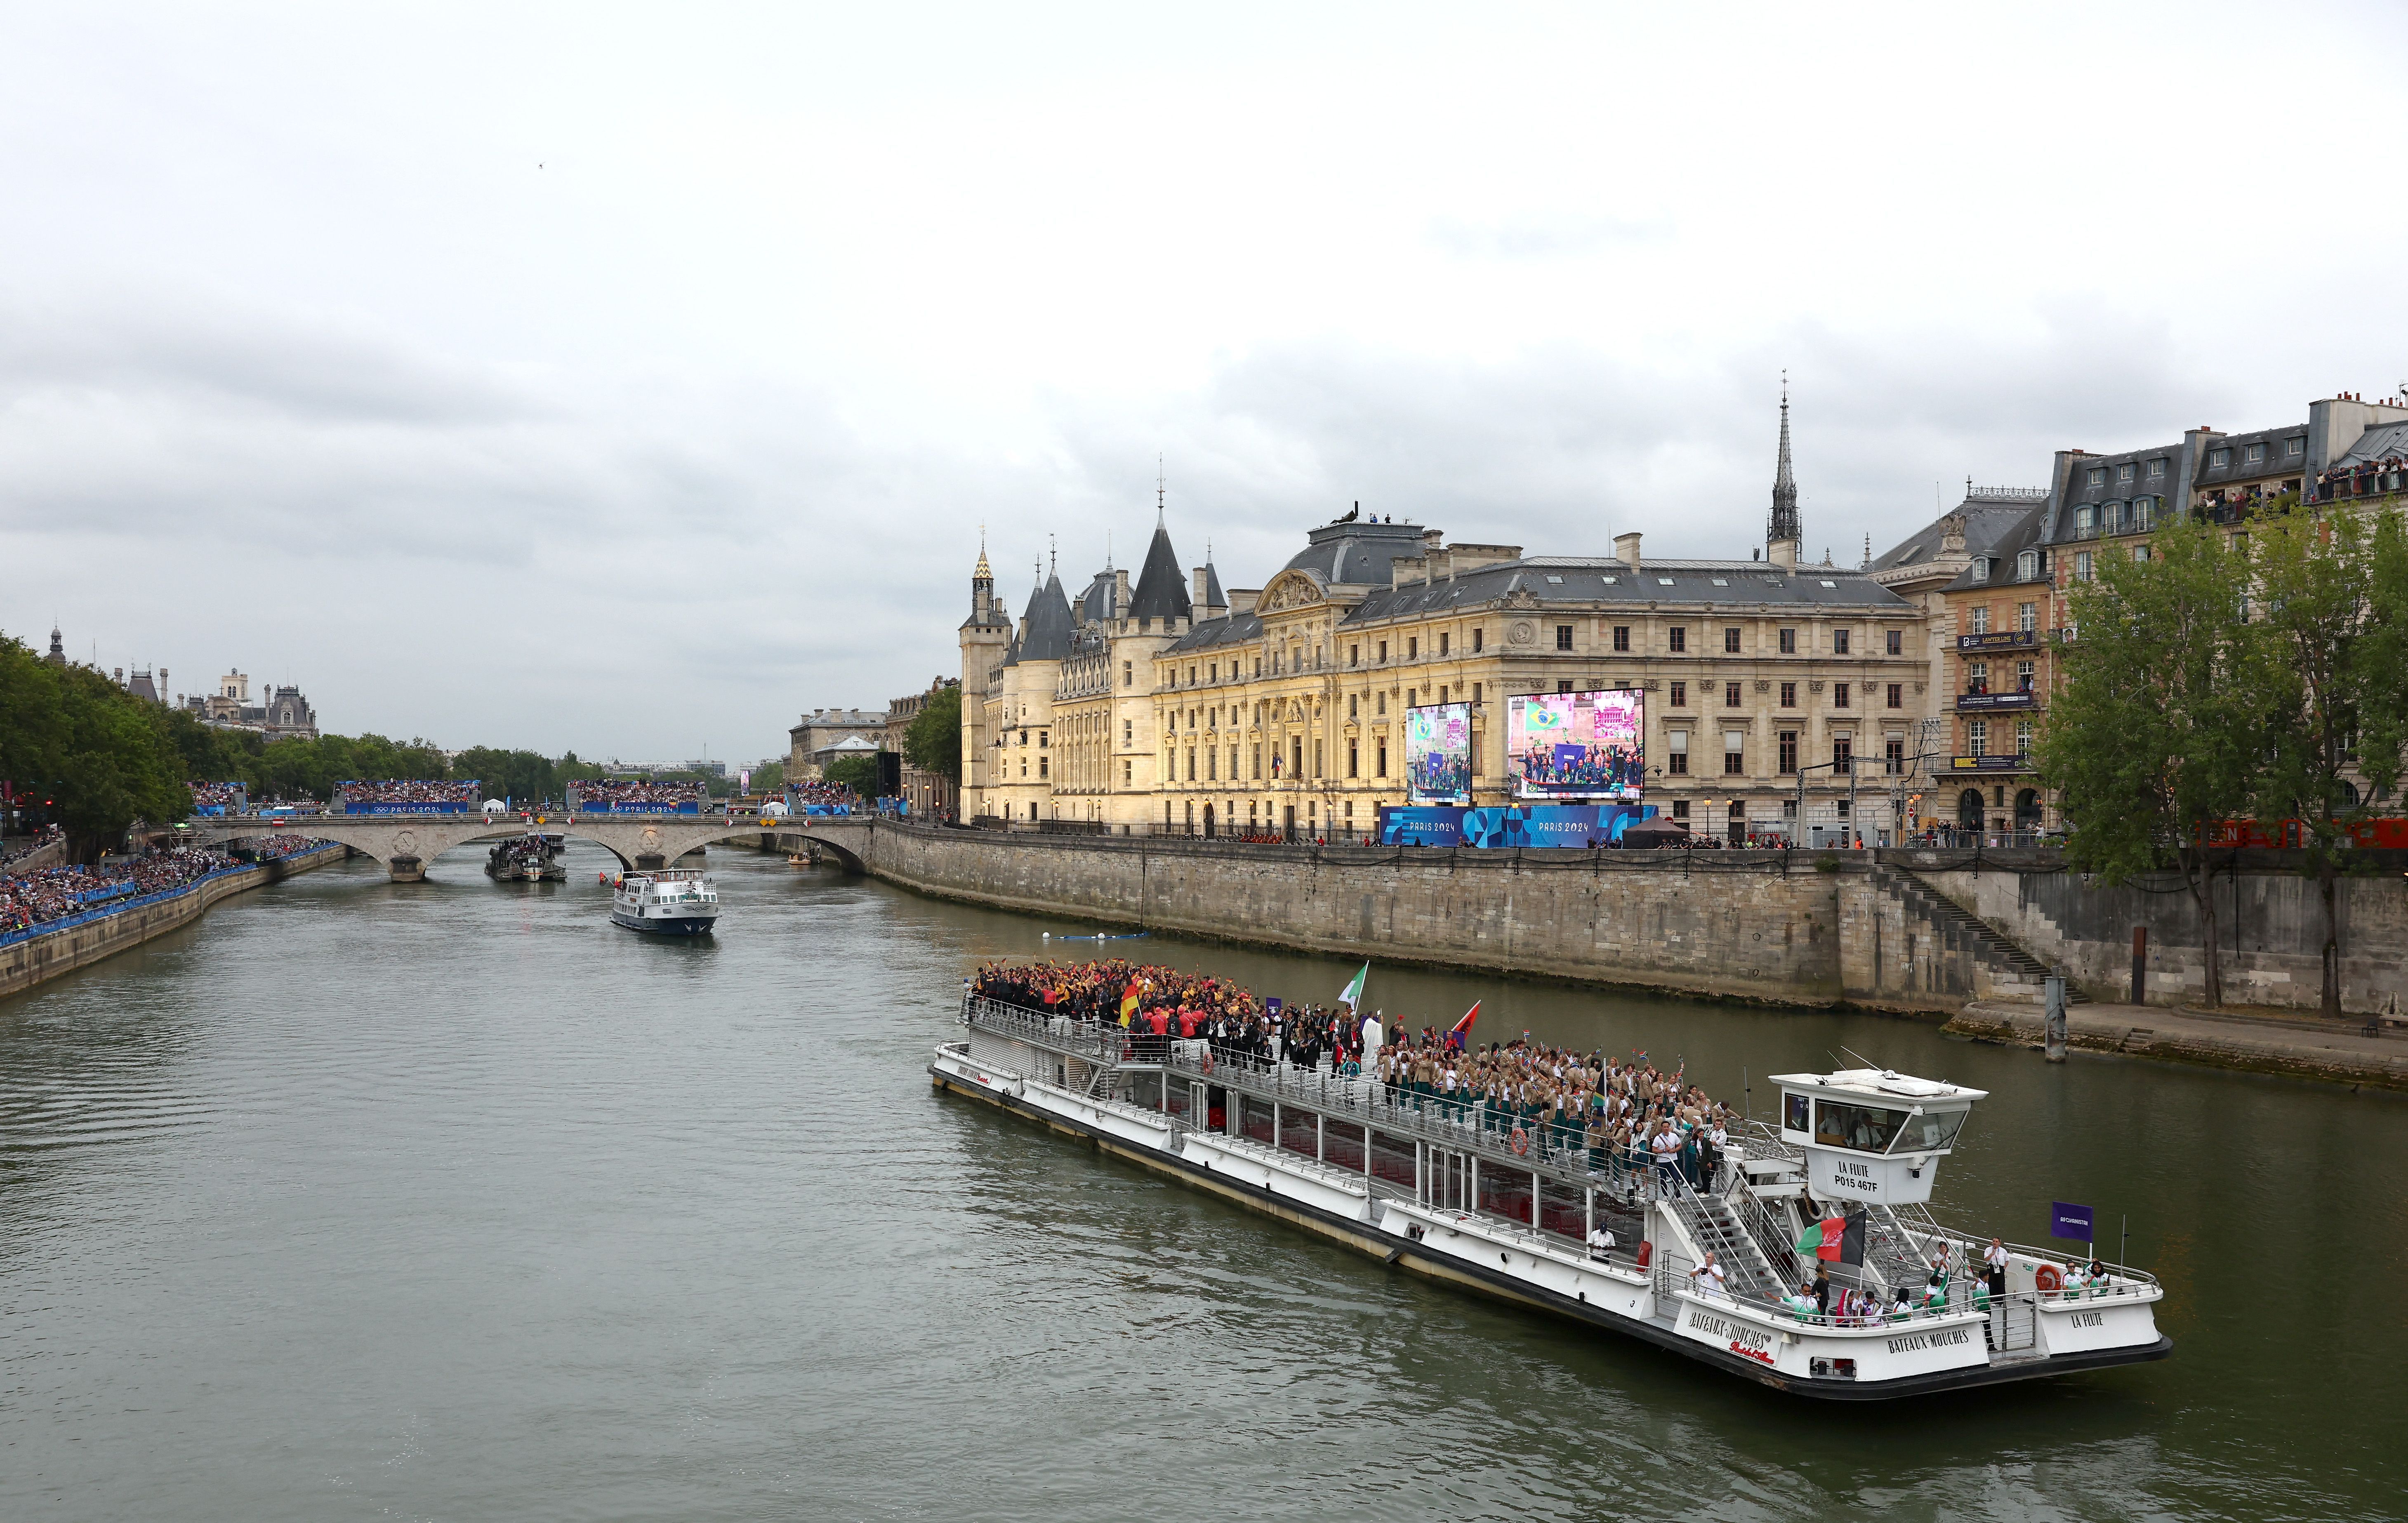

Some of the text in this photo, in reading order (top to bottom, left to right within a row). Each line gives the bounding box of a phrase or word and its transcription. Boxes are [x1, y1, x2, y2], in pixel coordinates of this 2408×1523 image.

[1435, 822, 1454, 831] 2024
[1564, 822, 1588, 832] 2024
[1838, 1161, 1869, 1177] LA FLUTE
[1857, 1180, 1877, 1192] 467F
[2060, 1217, 2088, 1226] AFGHANISTAN
[2071, 1313, 2103, 1328] LA FLUTE
[1729, 1341, 1746, 1354] Pont
[1887, 1330, 1969, 1354] BATEAUX-MOUCHES
